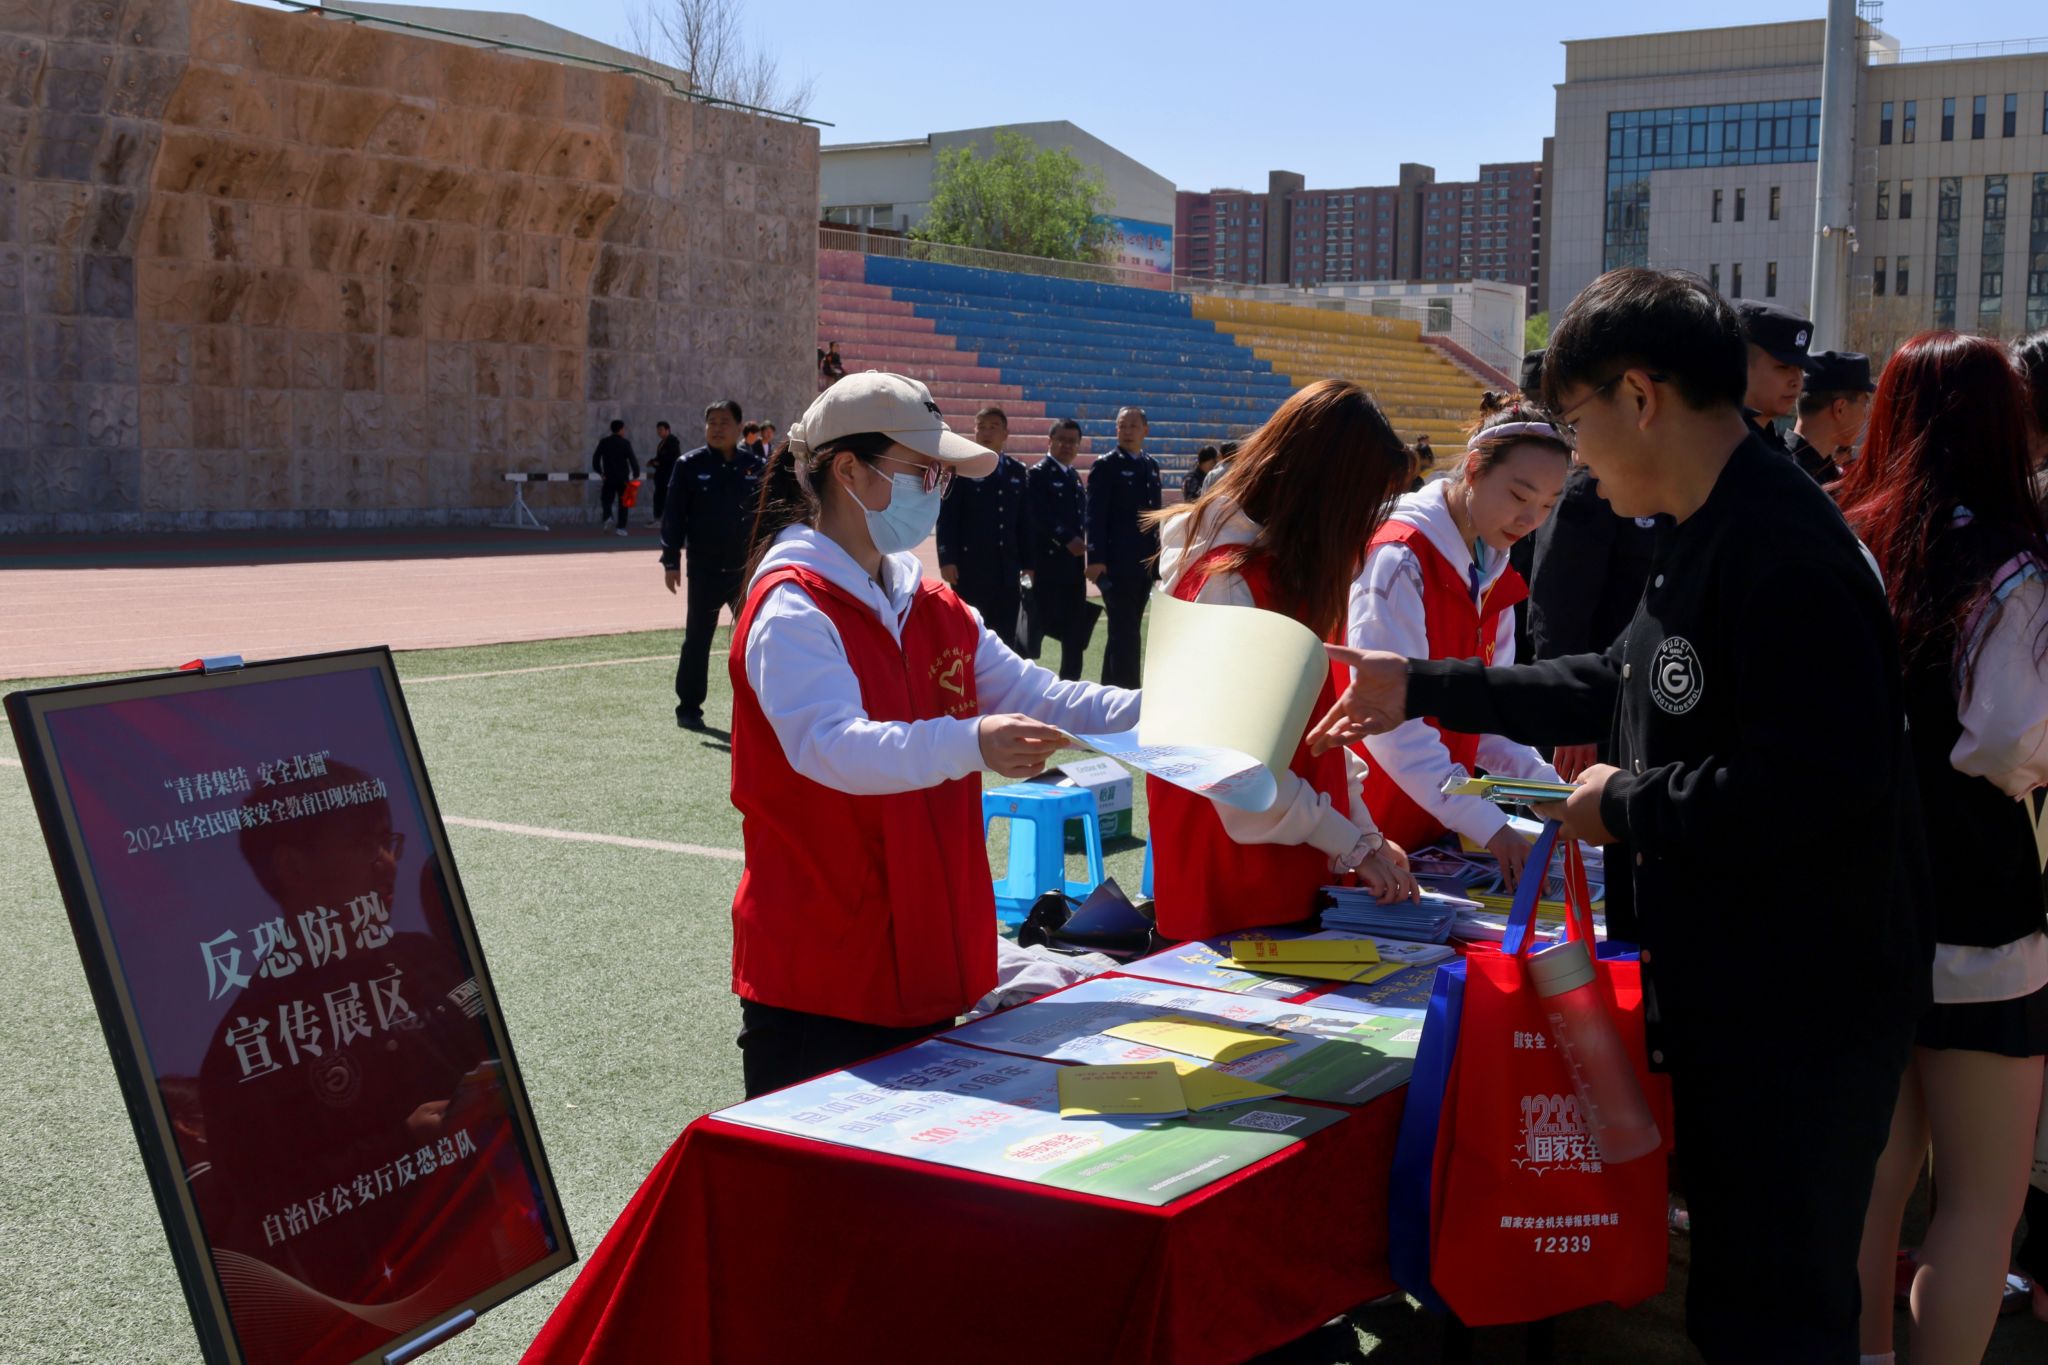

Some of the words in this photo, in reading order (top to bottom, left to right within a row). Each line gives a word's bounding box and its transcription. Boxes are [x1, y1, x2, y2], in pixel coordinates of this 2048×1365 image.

[1662, 661, 1689, 694] G
[123, 777, 388, 854] 2024年全民国家安全教育日现场活动
[199, 890, 394, 1001] 反恐防恐
[224, 966, 417, 1084] 宣传展区
[1534, 1134, 1601, 1162] 国家安全
[261, 1128, 478, 1247] 自治区公安厅反恐总队
[1500, 1212, 1619, 1229] 国家安全机关举报受理电话
[1534, 1235, 1591, 1253] 12339
